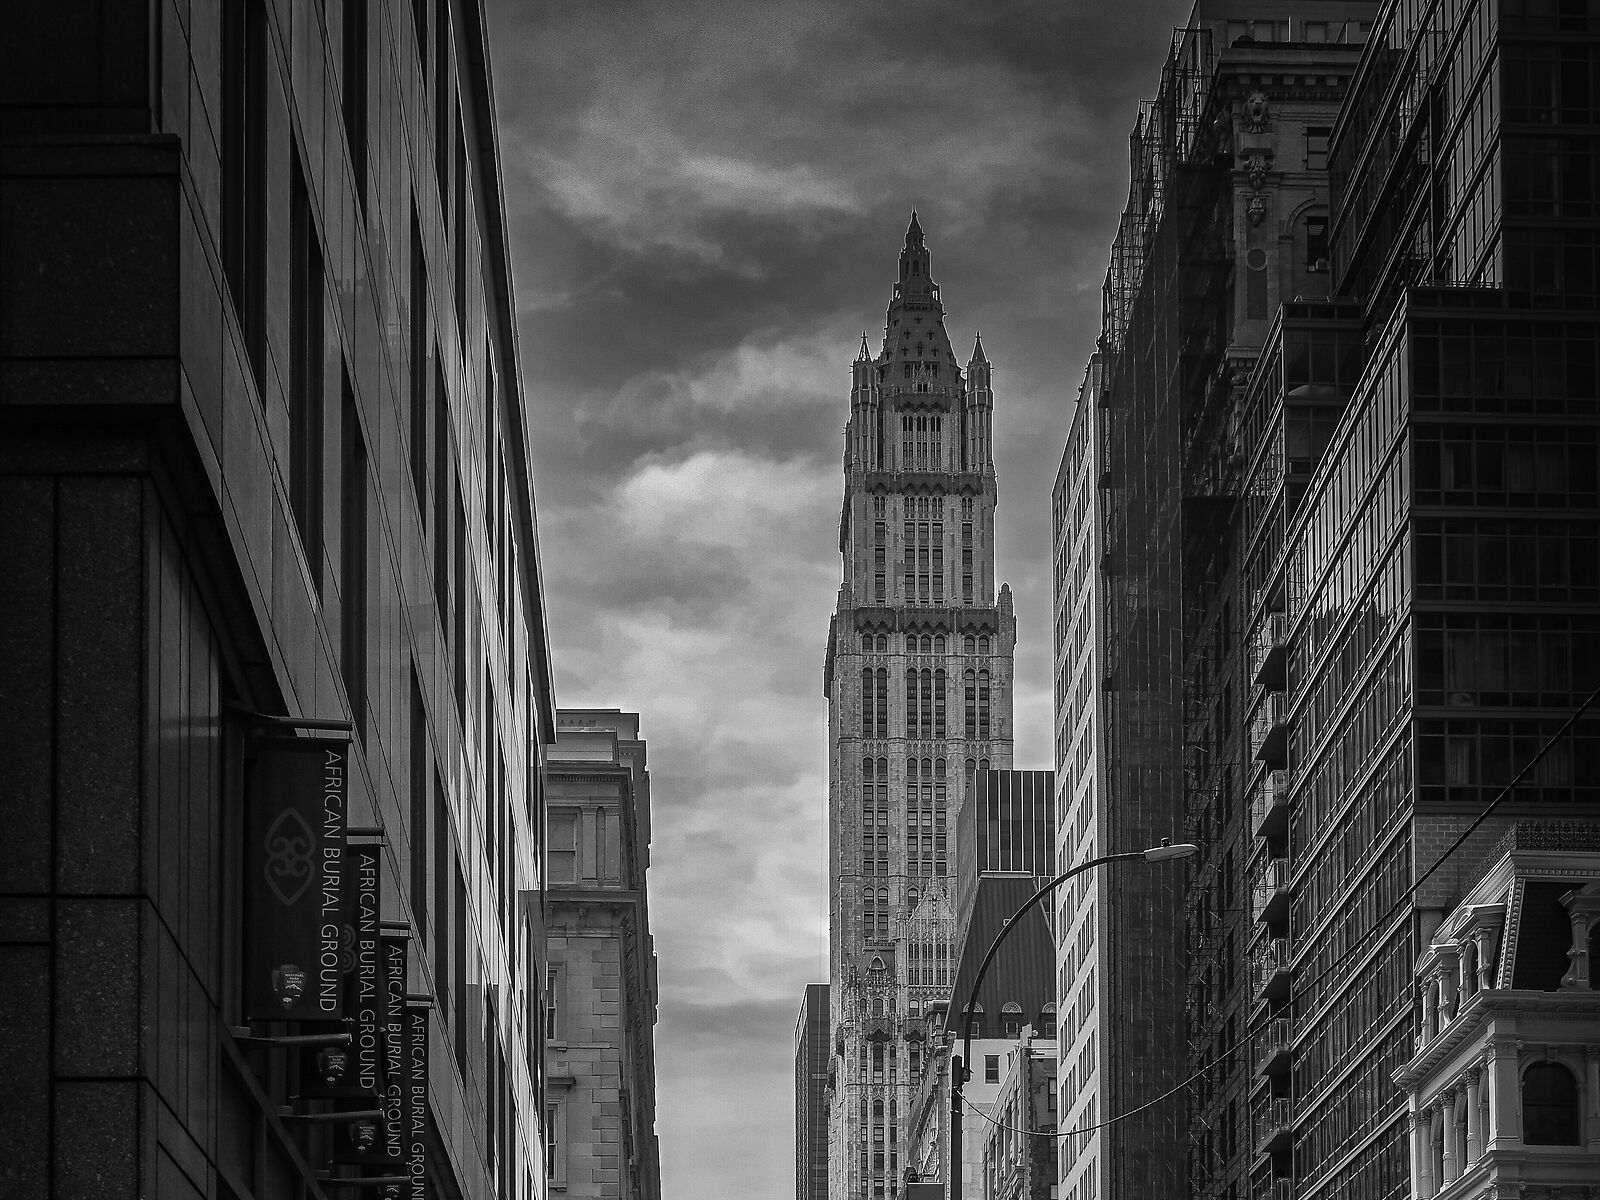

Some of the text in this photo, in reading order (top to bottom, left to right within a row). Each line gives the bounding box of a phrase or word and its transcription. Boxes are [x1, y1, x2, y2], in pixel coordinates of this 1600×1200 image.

[320, 749, 342, 1011] AFRICAN BURIAL GROUND
[359, 853, 376, 1089] AFRICAN BURIAL GROUND
[387, 944, 403, 1157] AFRICAN BURIAL GROUND
[411, 1014, 425, 1080] AFRICAN
[411, 1086, 425, 1138] BURIAL
